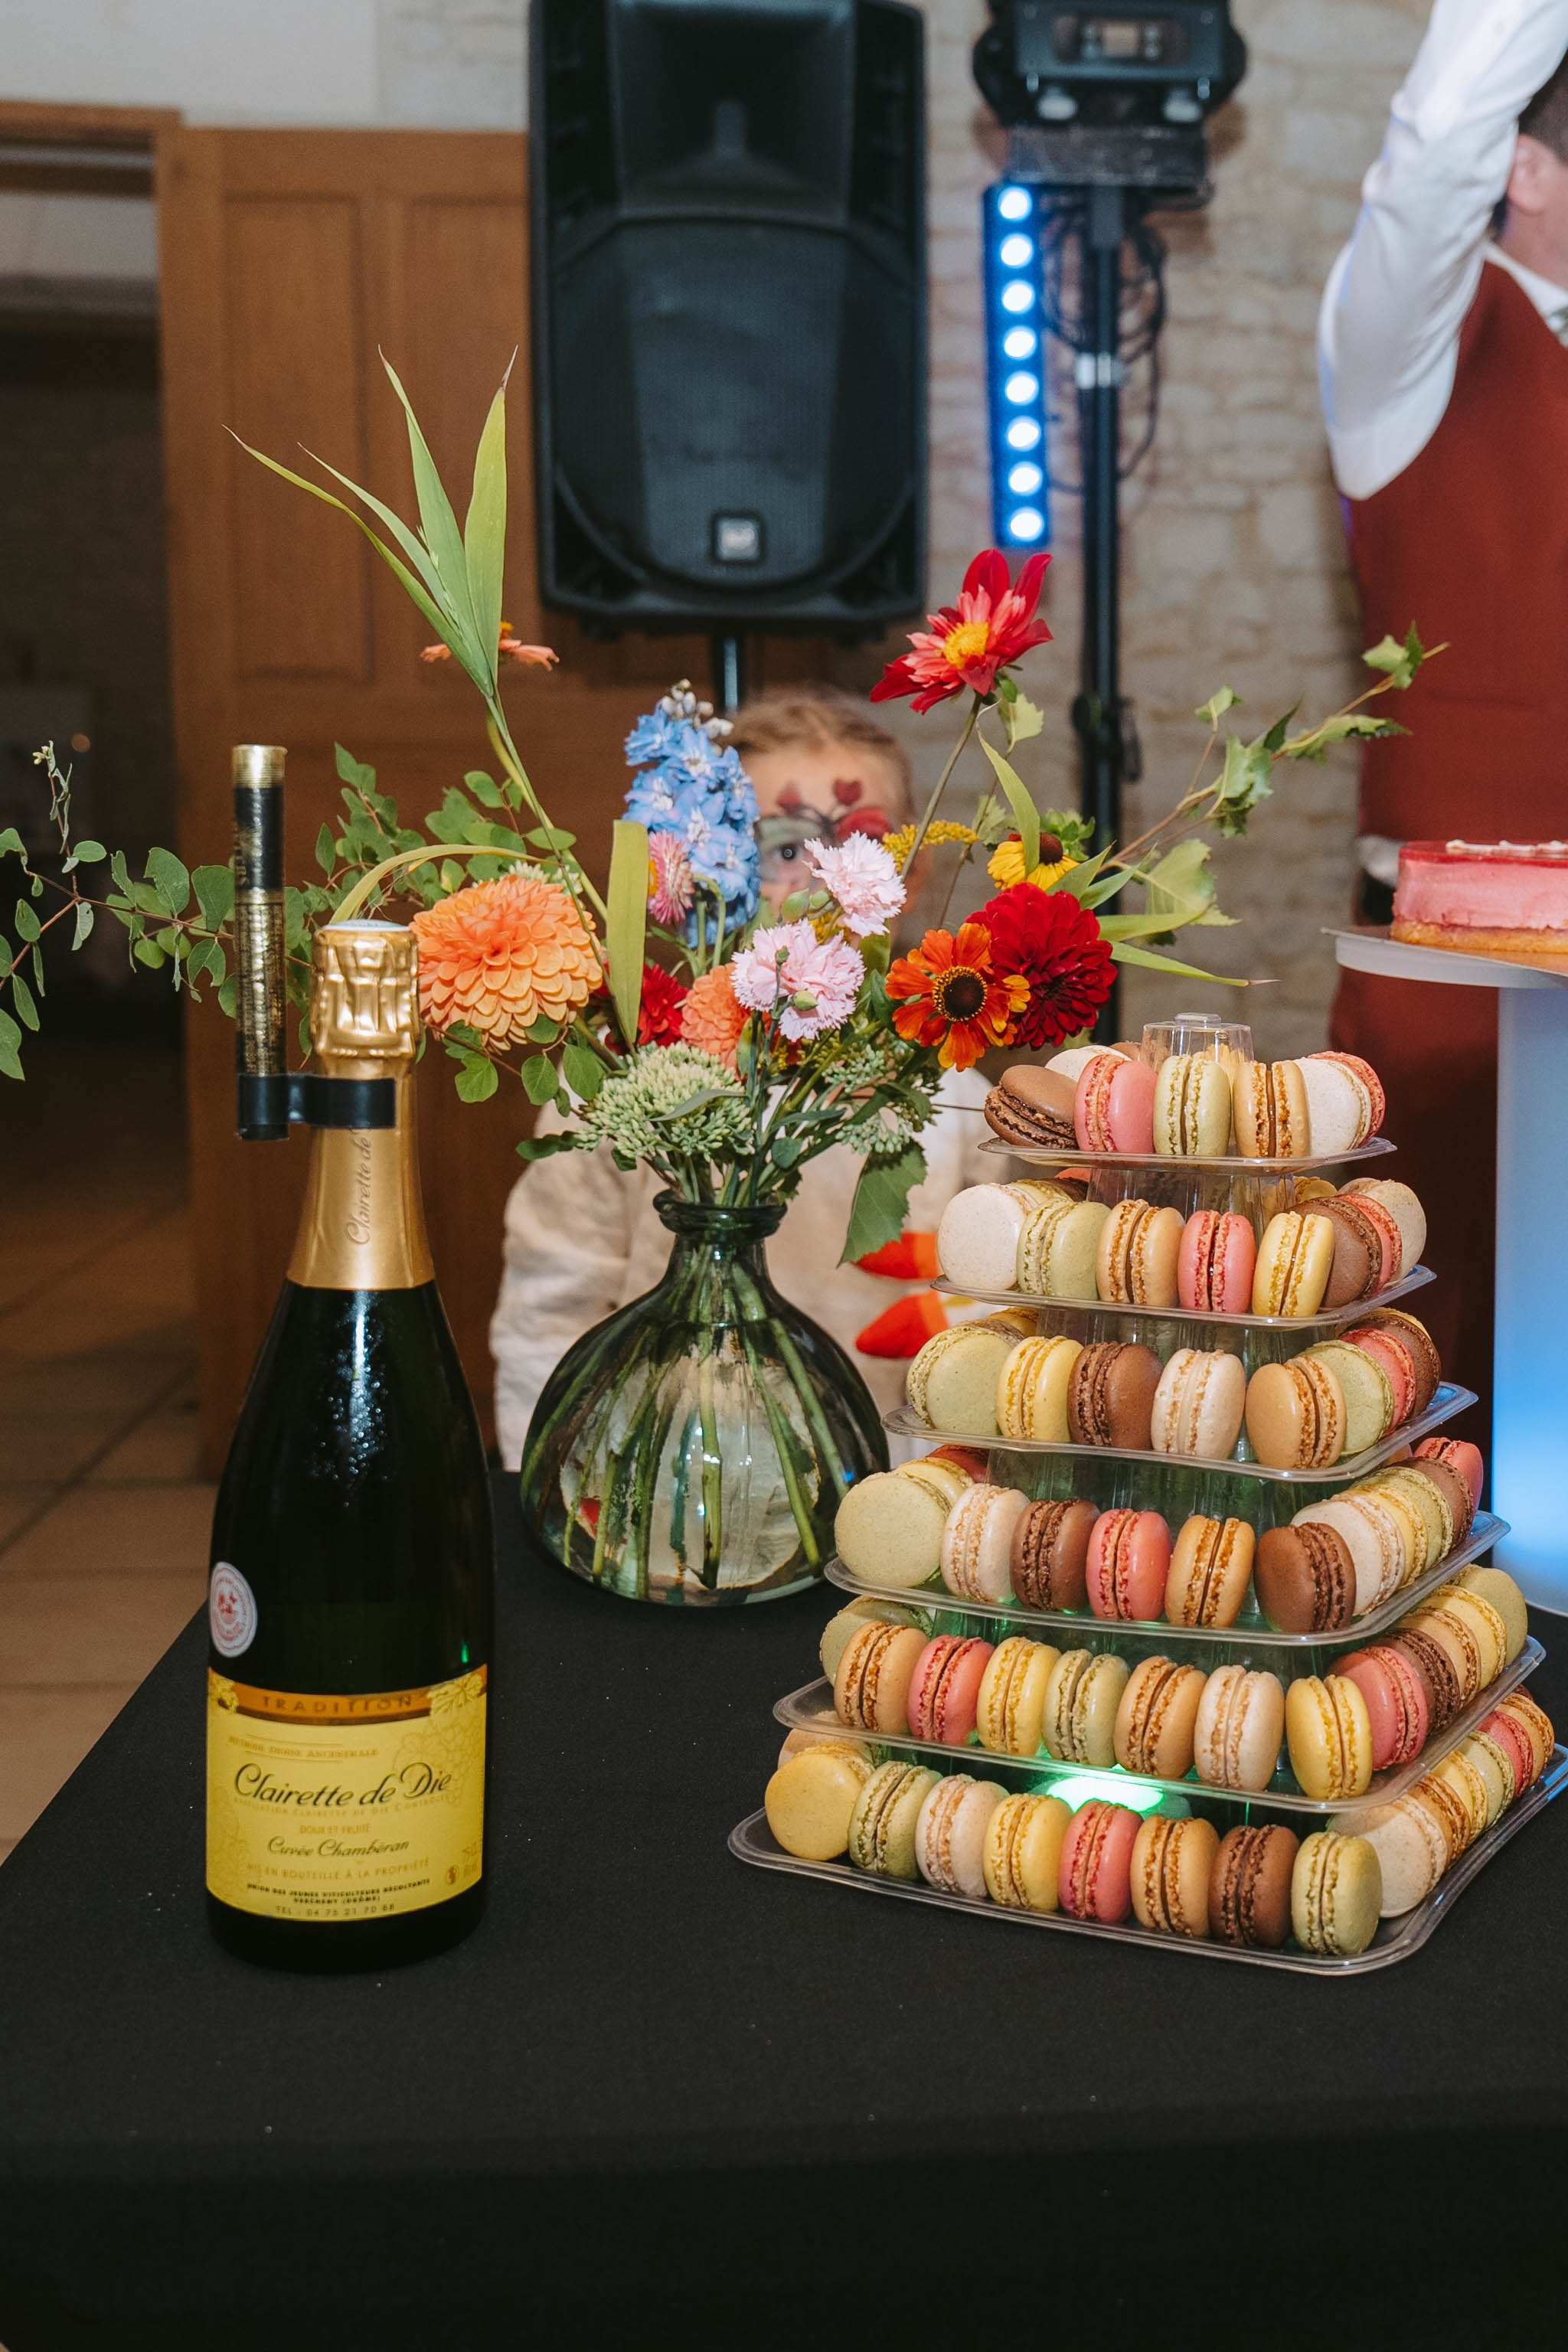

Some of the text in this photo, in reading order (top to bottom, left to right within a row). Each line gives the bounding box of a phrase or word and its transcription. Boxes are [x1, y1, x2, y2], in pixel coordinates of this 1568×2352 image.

[352, 1137, 371, 1160] de
[346, 1162, 371, 1245] Clairette
[263, 1695, 413, 1713] TRADITION
[234, 1762, 452, 1806] Clairette de Die
[299, 1824, 325, 1834] DOUX
[328, 1824, 338, 1834] ET
[268, 1836, 314, 1856] Cuvée
[282, 1869, 339, 1880] BOUTEILLE
[358, 1867, 370, 1877] LA
